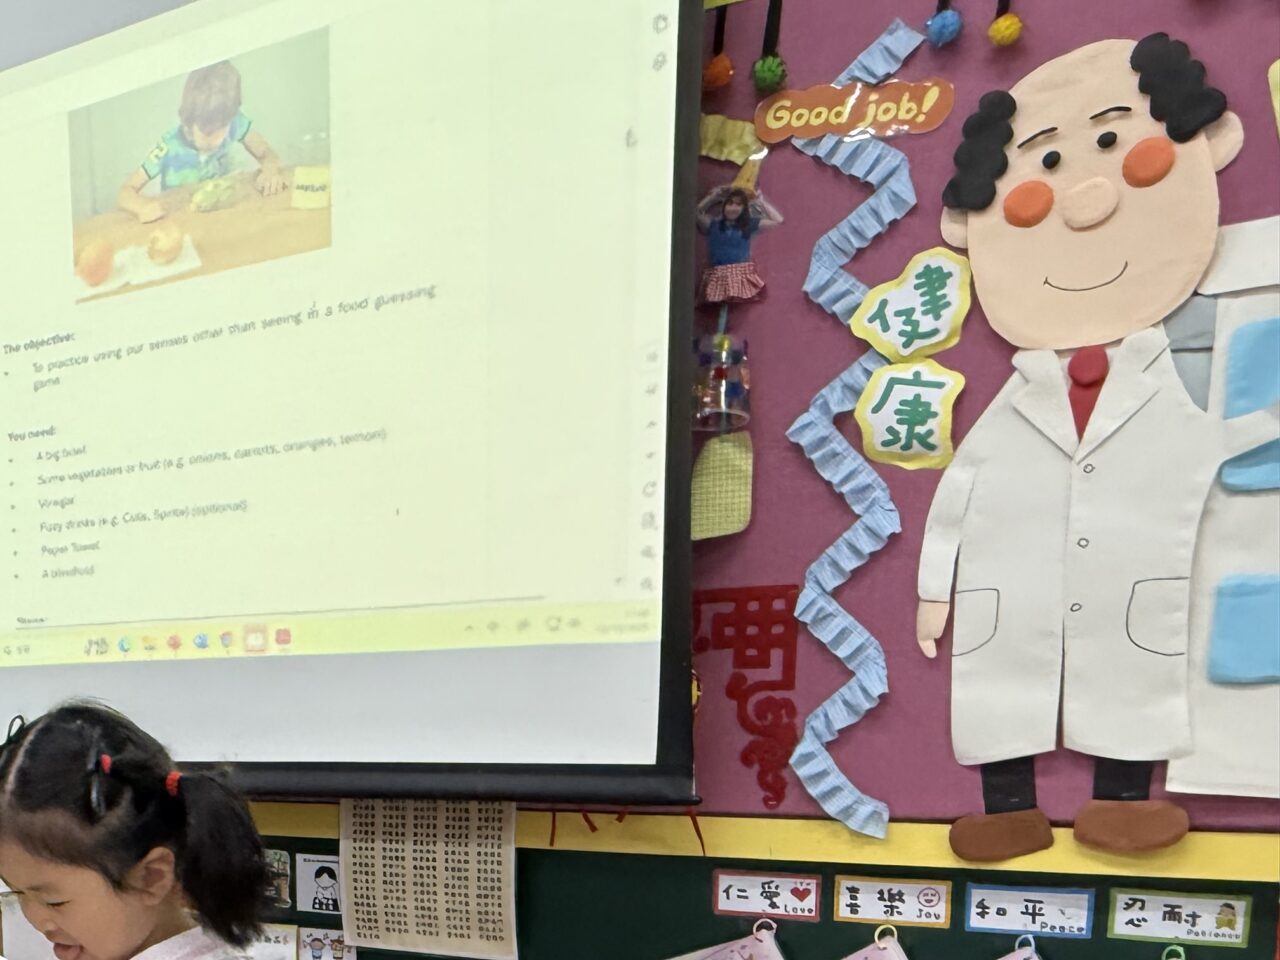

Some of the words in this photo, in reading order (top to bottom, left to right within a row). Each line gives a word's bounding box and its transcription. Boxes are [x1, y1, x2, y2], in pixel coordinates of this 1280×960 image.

[766, 97, 852, 130] Good
[856, 86, 940, 128] job!
[338, 298, 369, 314] food
[374, 284, 437, 311] guessing
[8, 431, 26, 442] You
[722, 880, 781, 910] 仁愛
[784, 903, 814, 915] Love
[845, 885, 906, 917] 喜樂
[975, 898, 1046, 924] 和平
[1123, 898, 1202, 928] 忍耐
[1040, 921, 1085, 933] Peace
